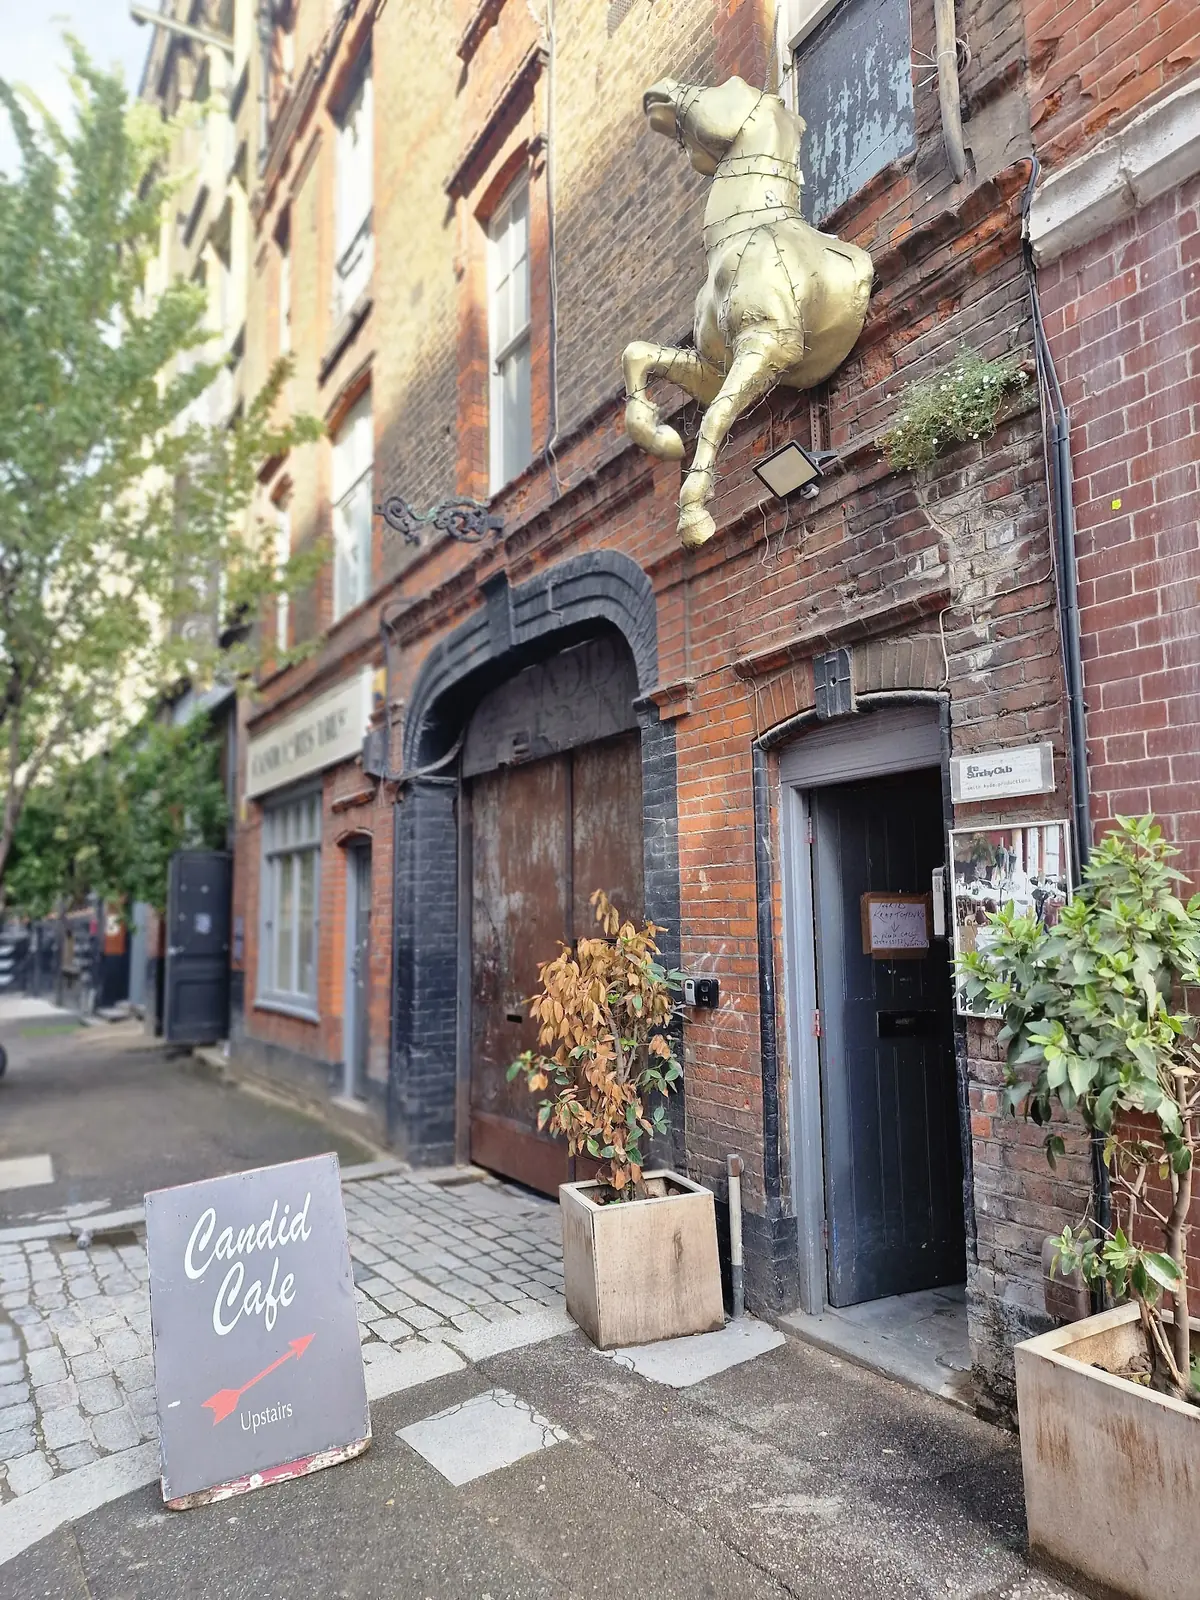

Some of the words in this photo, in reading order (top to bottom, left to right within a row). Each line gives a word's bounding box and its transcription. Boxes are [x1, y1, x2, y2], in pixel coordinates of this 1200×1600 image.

[184, 1192, 312, 1279] Candid
[212, 1257, 297, 1336] Cafe
[240, 1402, 293, 1433] Upstairs
